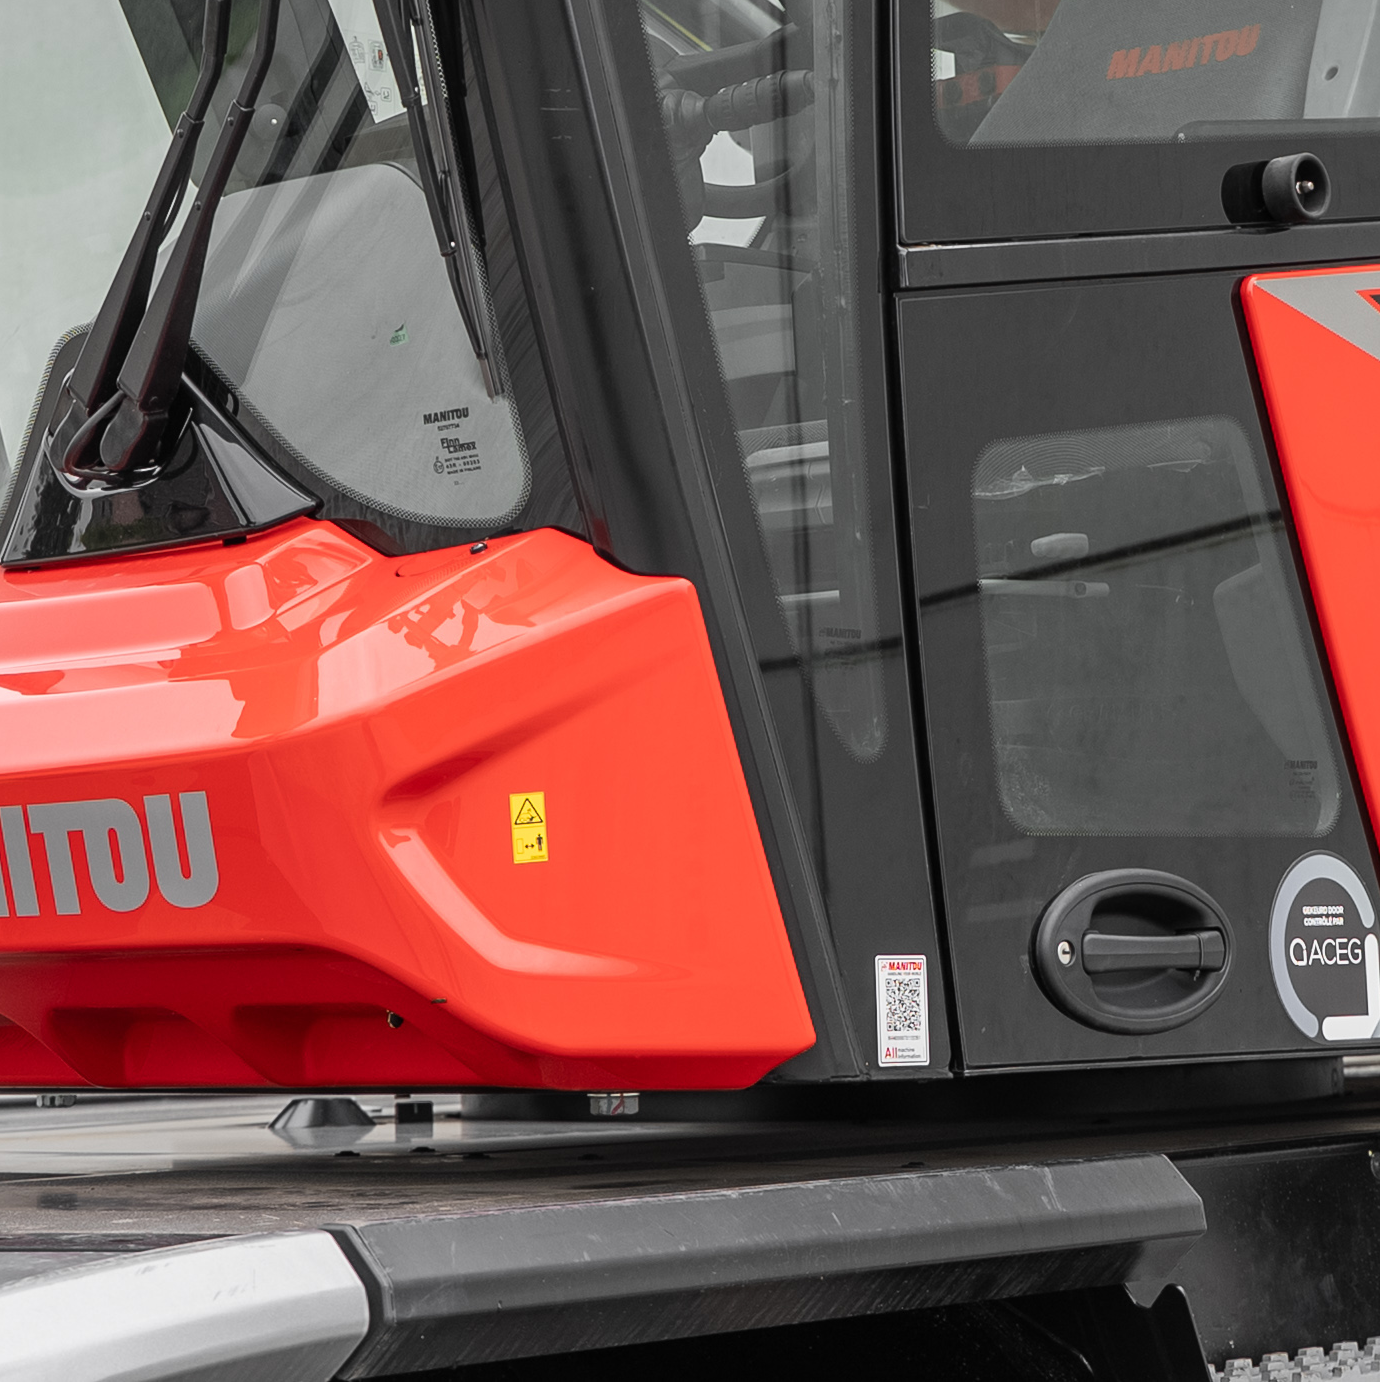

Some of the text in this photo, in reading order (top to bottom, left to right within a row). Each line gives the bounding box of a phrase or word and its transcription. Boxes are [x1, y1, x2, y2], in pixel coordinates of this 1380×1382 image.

[1106, 23, 1261, 80] MANITOU
[423, 407, 469, 425] MANITOU
[888, 961, 923, 971] MANITOU
